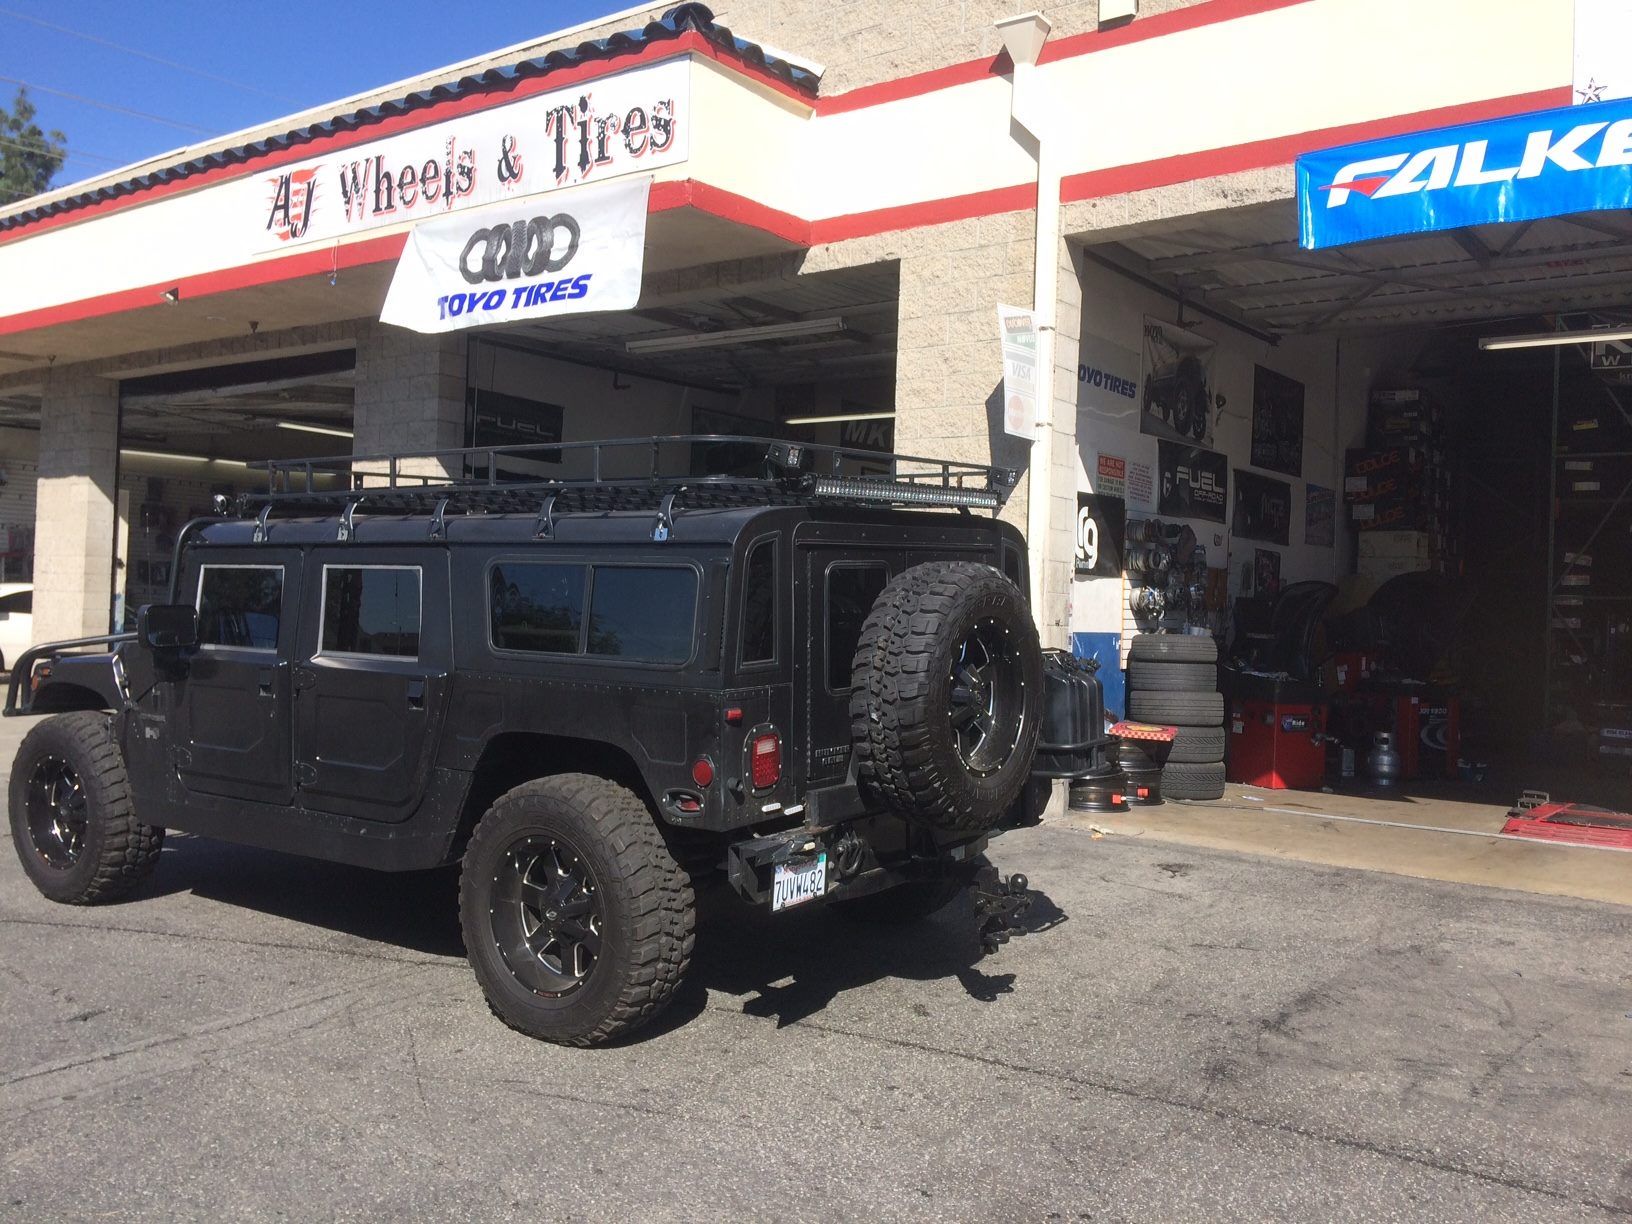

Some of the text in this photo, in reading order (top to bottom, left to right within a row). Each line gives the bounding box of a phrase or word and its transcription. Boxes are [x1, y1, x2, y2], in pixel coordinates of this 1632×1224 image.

[266, 94, 676, 239] AJ Wheels & Tires
[437, 273, 593, 321] TOYO TIRES
[1012, 362, 1031, 381] VISA
[1103, 372, 1137, 400] TIRES
[477, 414, 556, 438] FUEL
[1176, 465, 1224, 493] FUEL
[776, 869, 823, 904] 7UVW482
